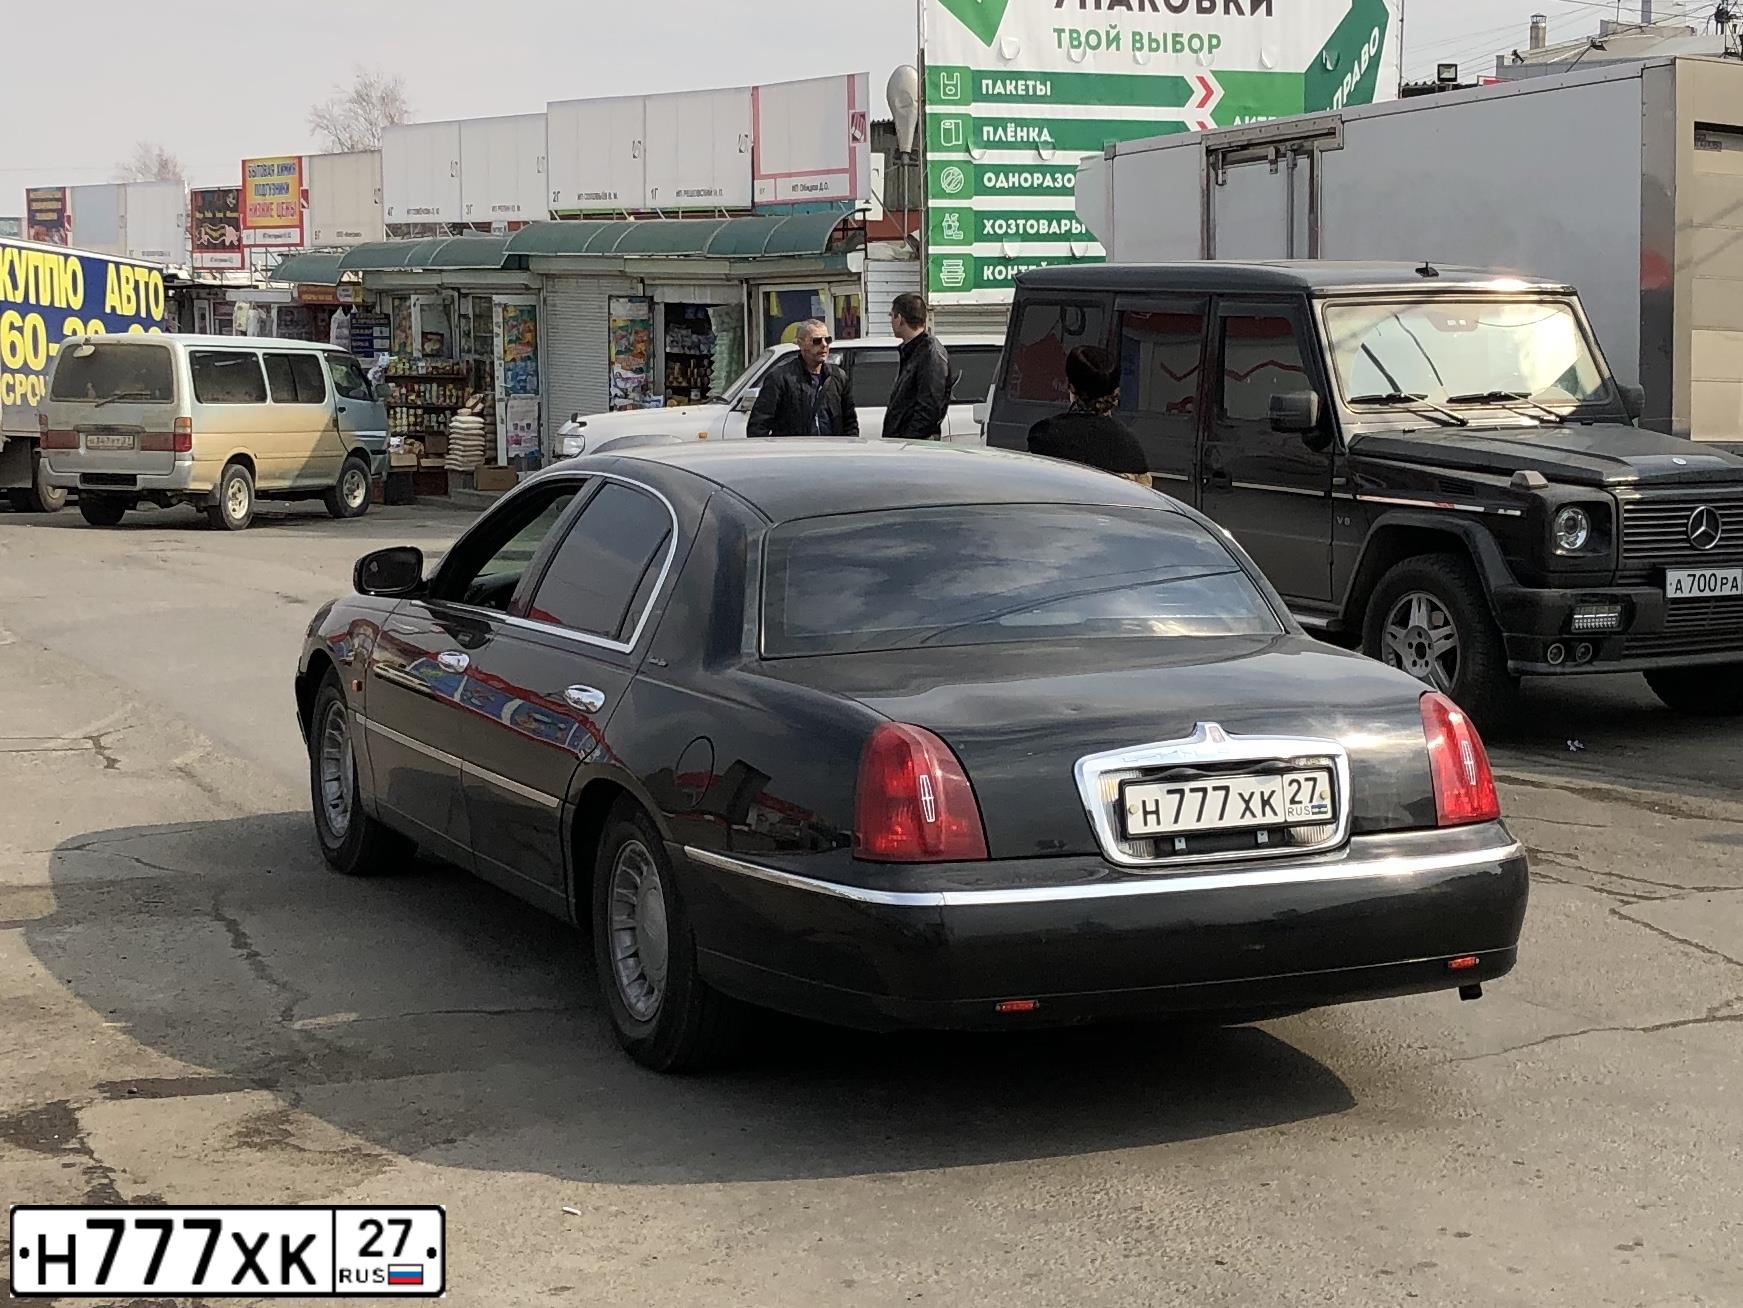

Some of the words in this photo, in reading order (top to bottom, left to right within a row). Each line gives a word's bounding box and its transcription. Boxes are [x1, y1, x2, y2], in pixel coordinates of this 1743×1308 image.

[1053, 23, 1122, 52] ТВОЙ
[1131, 30, 1222, 55] ВЫБОР
[1326, 26, 1380, 111] ПРАВО
[981, 79, 1051, 97] ПАКЕТЫ
[982, 122, 1051, 142] ПЛЁНКА
[983, 218, 1087, 235] ХОЗТОВАРЫ
[105, 261, 165, 322] АВТО
[1674, 572, 1739, 594] А700РА
[1141, 785, 1279, 827] Н777ХК
[1288, 776, 1318, 805] 27
[1287, 805, 1311, 817] RUS
